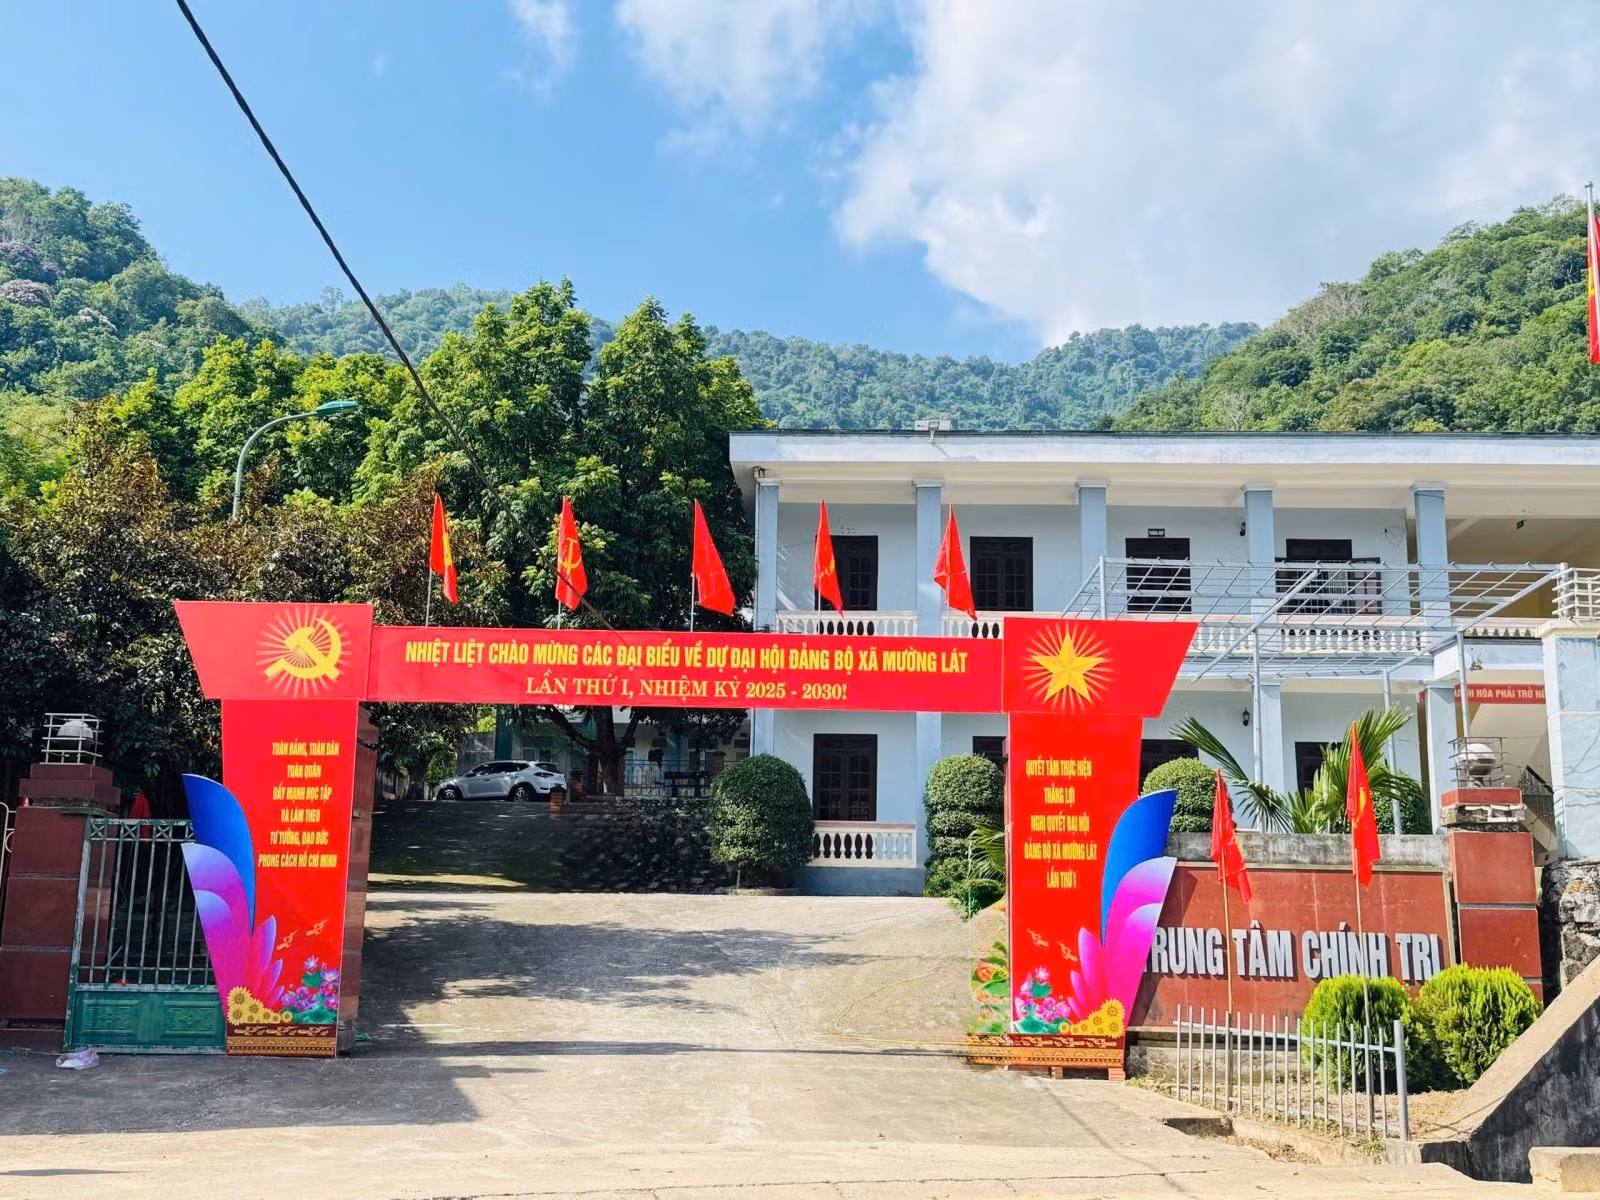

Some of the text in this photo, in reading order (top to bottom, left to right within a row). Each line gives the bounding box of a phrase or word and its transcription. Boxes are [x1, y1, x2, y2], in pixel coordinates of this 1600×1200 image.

[406, 637, 968, 675] NHIỆT LIỆT CHÀO MỪNG CÁC ĐẠI BIỂU VỀ DỰ ĐẠI HỘI ĐẢNG BỘ XÃ MƯỜNG LÁT
[526, 669, 568, 695] LẦN
[572, 673, 618, 696] THỨ
[620, 679, 635, 699] I,
[639, 675, 709, 701] NHIỆM
[714, 676, 742, 698] KỲ
[745, 682, 787, 699] 2025
[802, 683, 848, 700] 2030!
[305, 808, 320, 822] THEO
[1085, 840, 1098, 860] LÁT
[1144, 927, 1224, 975] RUNG
[1232, 919, 1294, 977] TÂM
[1302, 921, 1388, 979] CHÍNH
